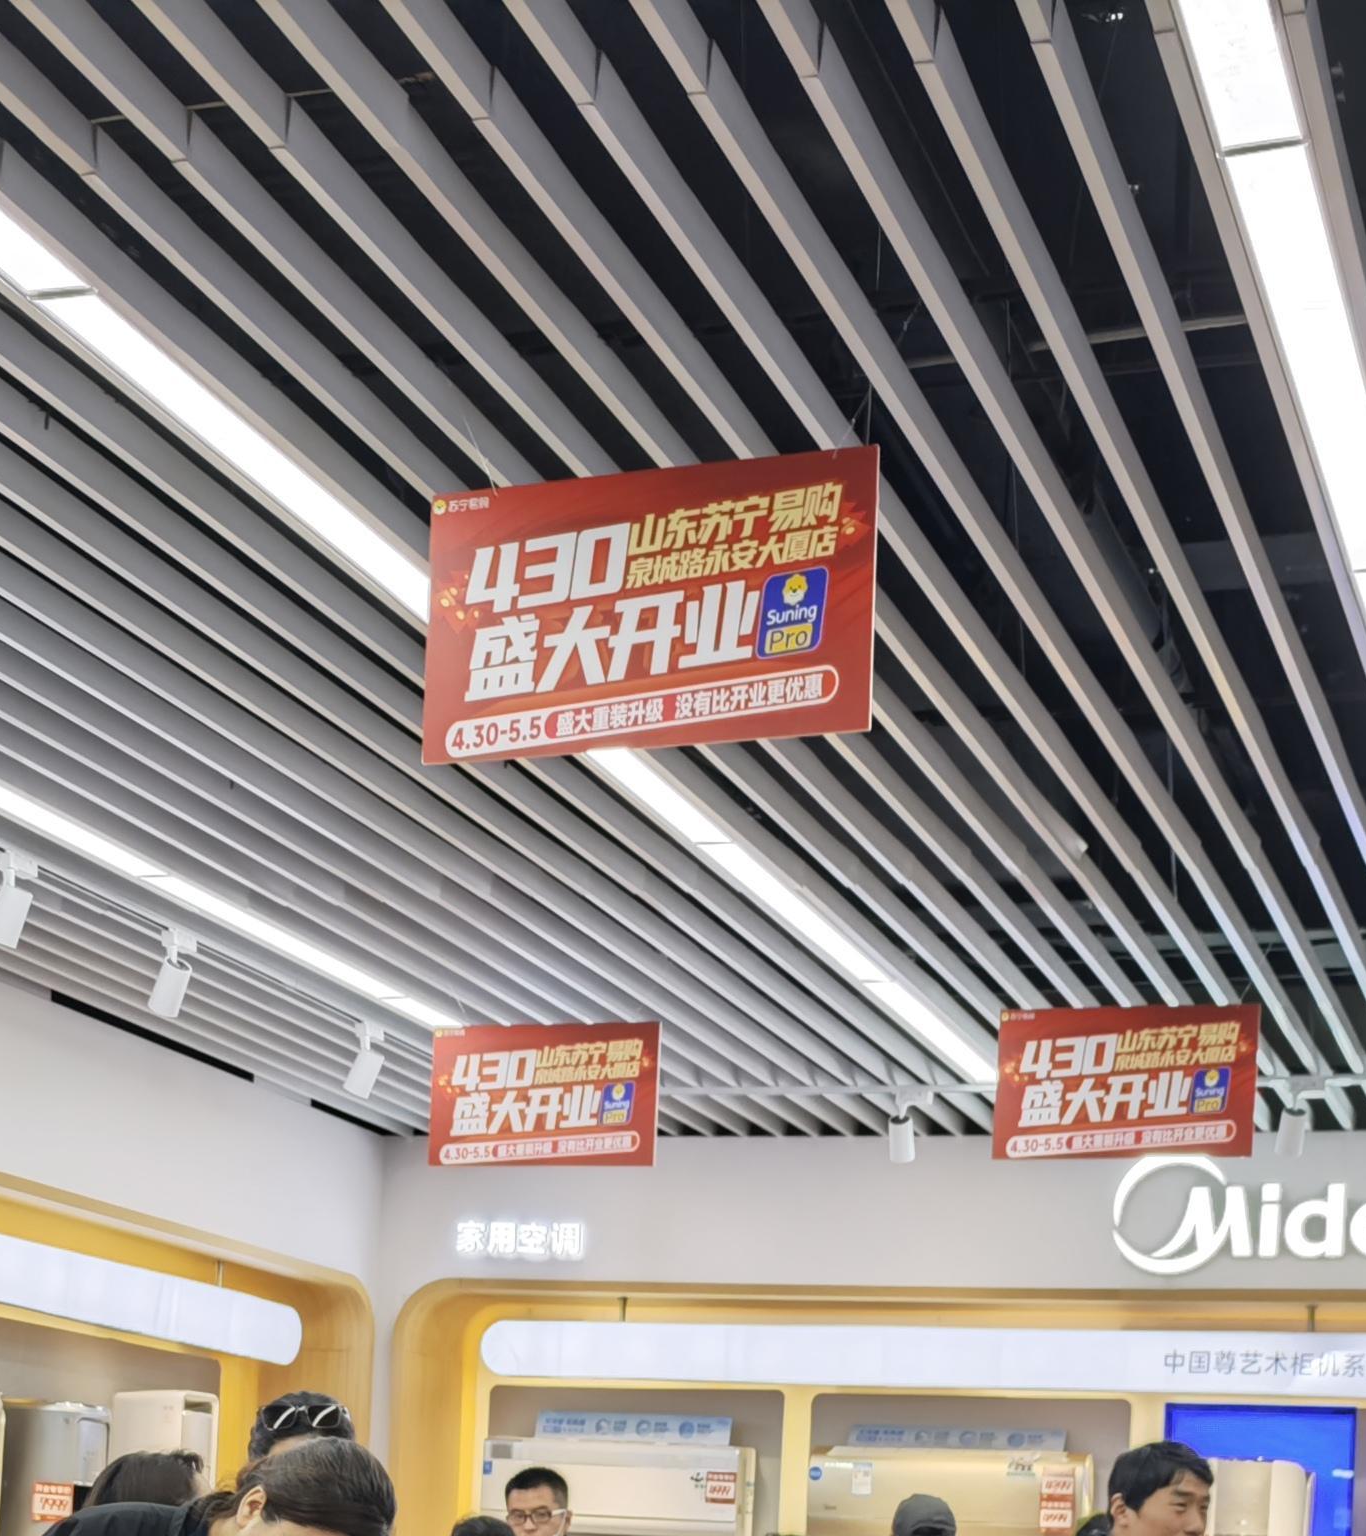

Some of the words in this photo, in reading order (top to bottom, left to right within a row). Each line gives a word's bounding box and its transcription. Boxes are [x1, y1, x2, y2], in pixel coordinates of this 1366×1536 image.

[629, 482, 842, 555] 山东苏宁易购
[465, 522, 631, 613] 430
[627, 527, 838, 589] 泉城路永安大厦店
[464, 580, 761, 702] 盛大开业
[767, 603, 817, 627] Suning
[769, 628, 809, 649] Pro
[451, 721, 542, 750] 4.30-5.5
[556, 698, 663, 738] 盛大重装升级
[675, 674, 823, 720] 没有比开业更优惠
[452, 1049, 536, 1091] 430
[1019, 1034, 1118, 1079] 430
[450, 1085, 601, 1137] 盛大开业
[1018, 1071, 1192, 1128] 盛大开业
[456, 1220, 584, 1256] 家用空调
